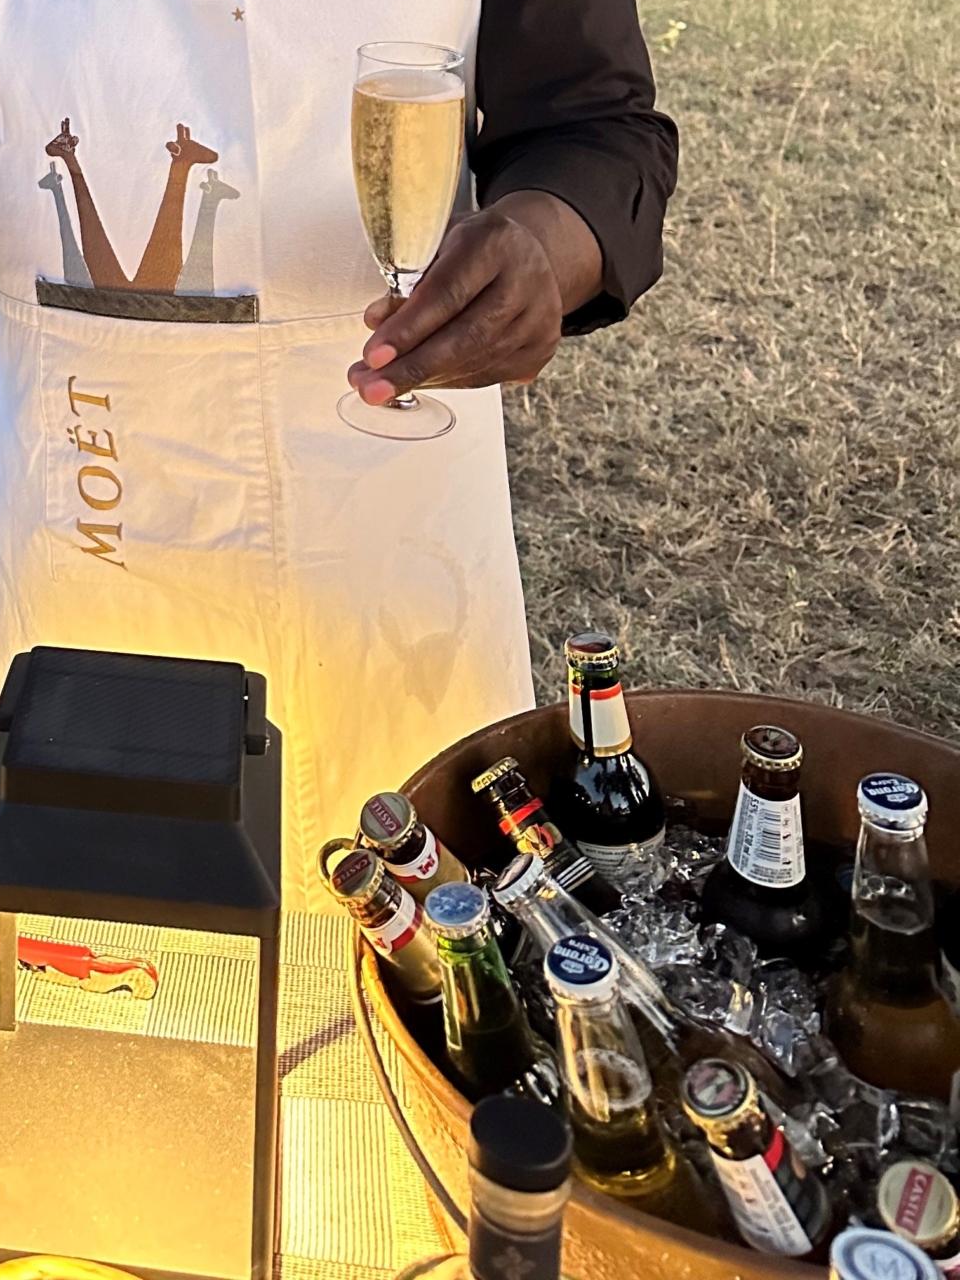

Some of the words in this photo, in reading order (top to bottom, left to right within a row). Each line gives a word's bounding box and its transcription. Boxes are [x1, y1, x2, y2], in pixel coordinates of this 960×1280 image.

[67, 375, 128, 571] MOËT
[866, 782, 920, 796] Corona
[371, 800, 397, 832] CASTLE
[336, 858, 369, 886] CASTLE
[553, 945, 610, 972] Corona
[568, 939, 599, 956] Extra
[902, 1174, 928, 1227] CASTLE
